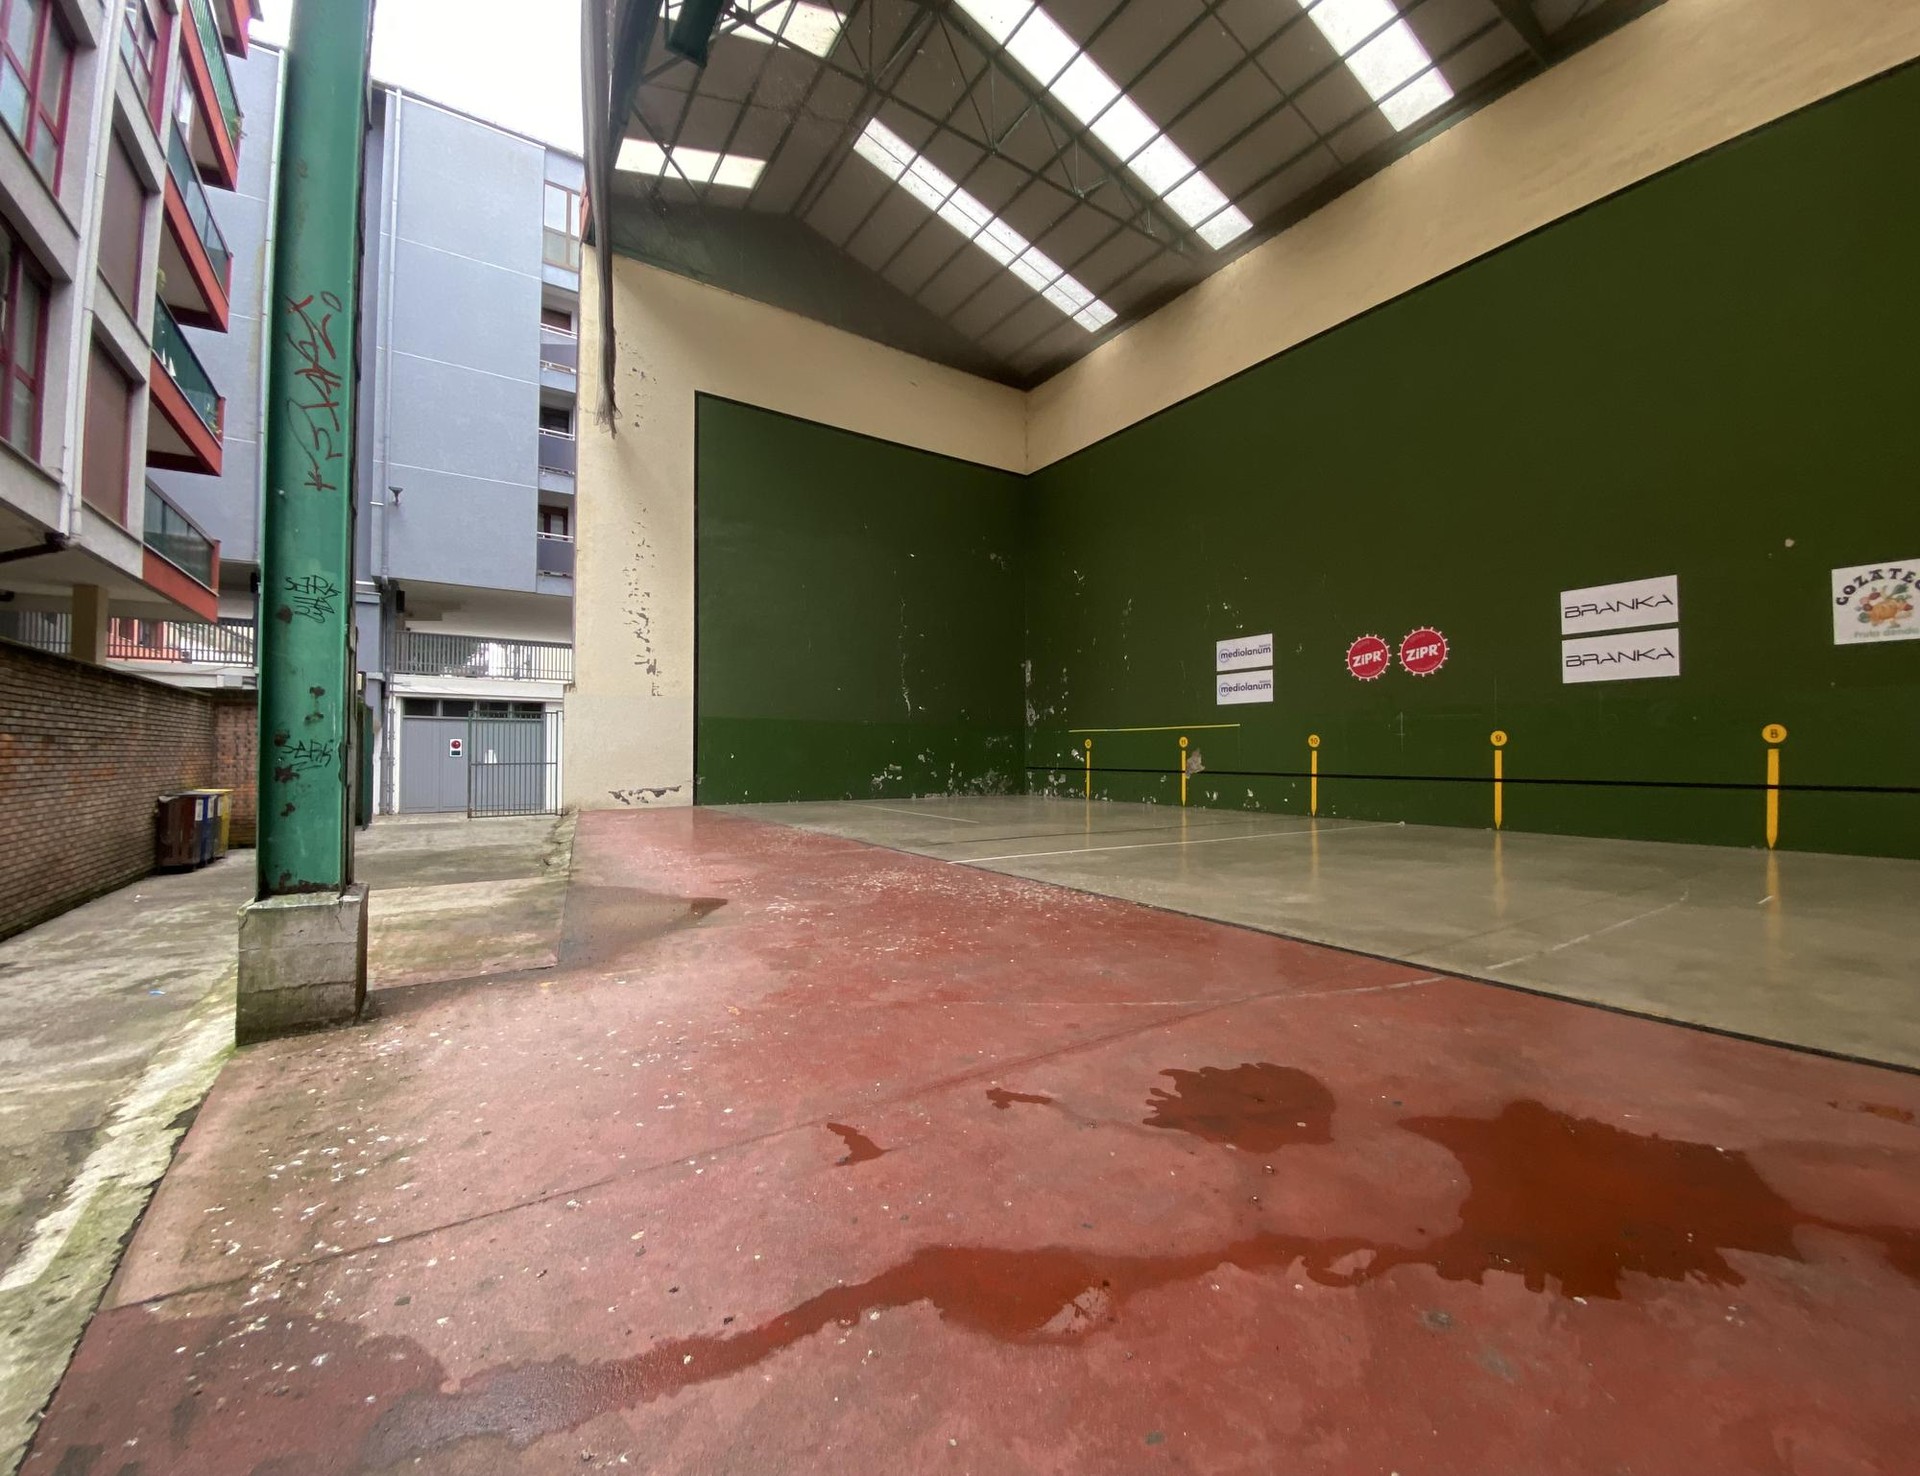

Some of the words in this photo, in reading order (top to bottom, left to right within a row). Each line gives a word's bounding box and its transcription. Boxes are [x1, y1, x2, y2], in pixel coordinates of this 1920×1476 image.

[1564, 594, 1674, 619] BRANKA
[1220, 647, 1272, 660] mediolanum
[1565, 647, 1675, 668] BRANKA
[1220, 683, 1272, 694] mediolanum
